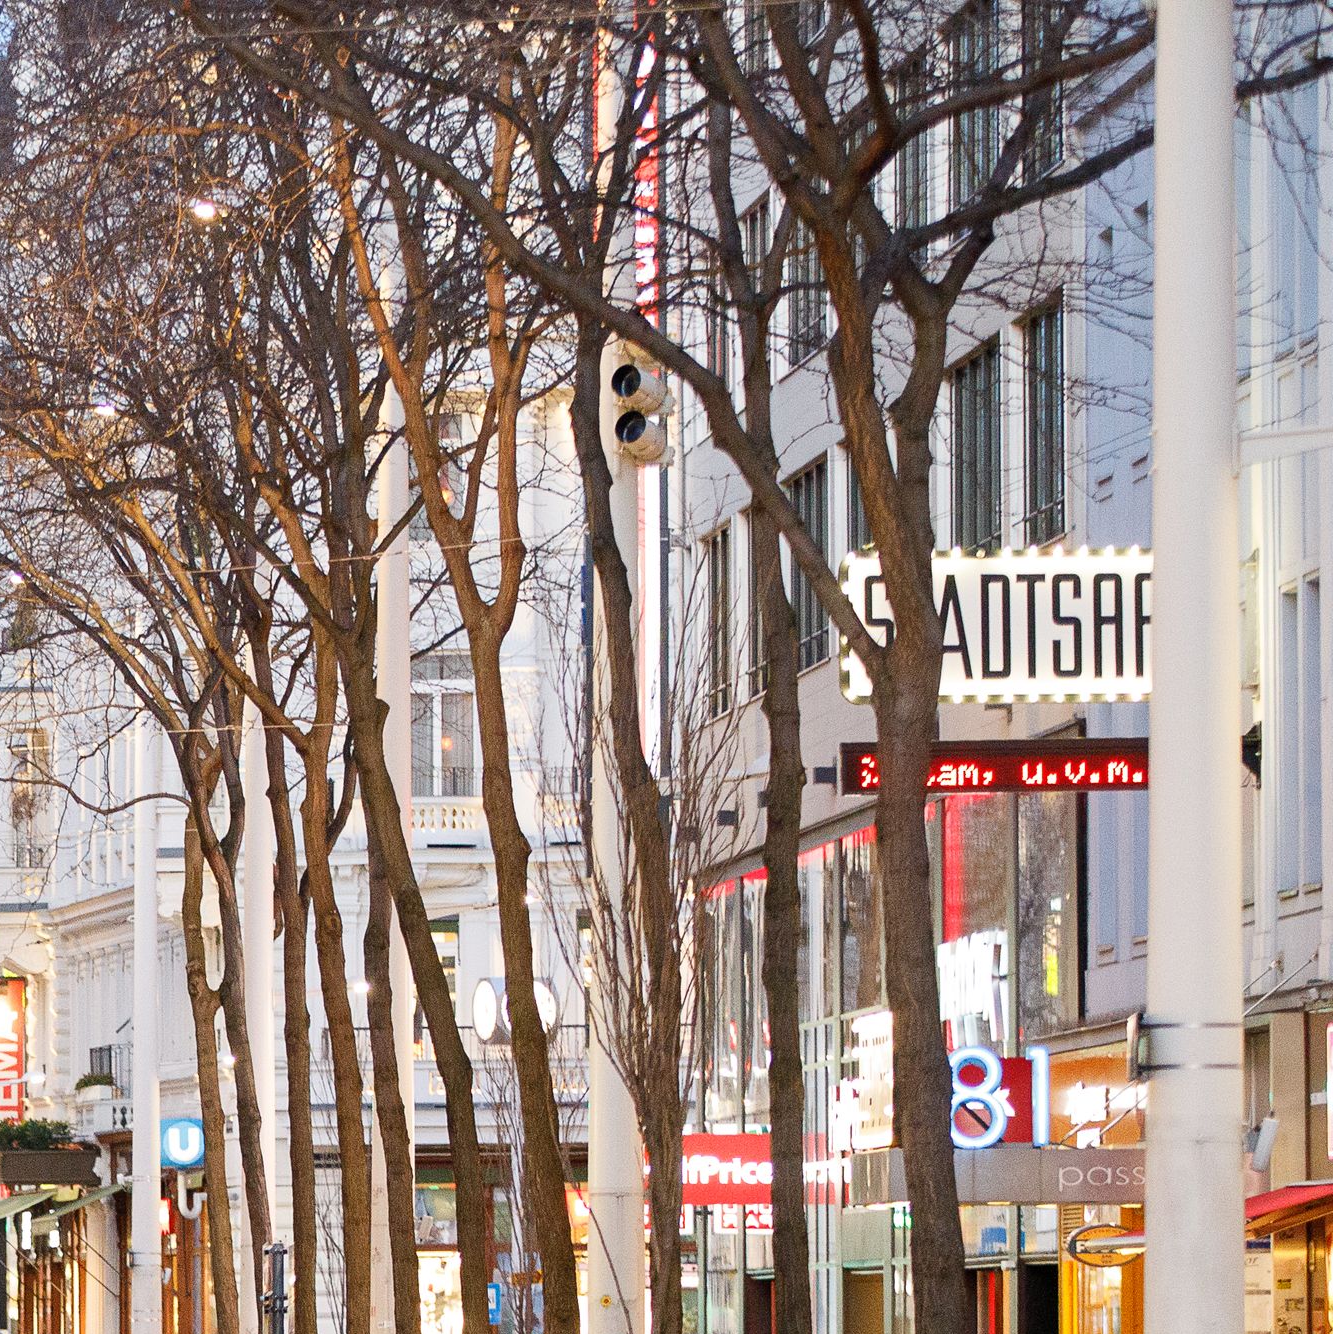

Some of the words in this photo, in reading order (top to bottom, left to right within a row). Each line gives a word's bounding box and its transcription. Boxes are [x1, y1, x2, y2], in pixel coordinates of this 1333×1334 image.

[950, 1045, 1051, 1148] 81
[168, 1127, 200, 1162] U
[1059, 1165, 1146, 1191] pass
